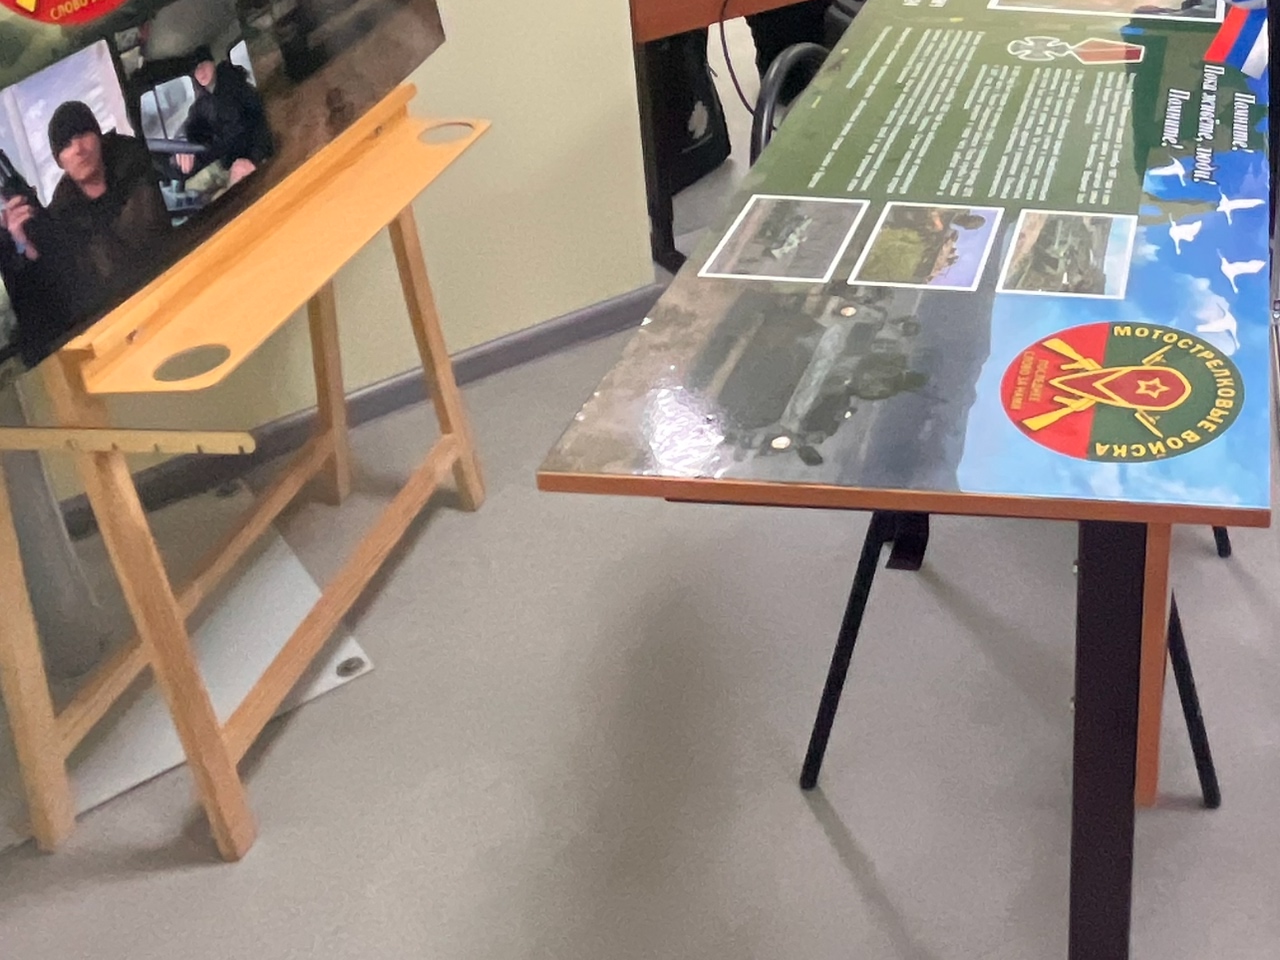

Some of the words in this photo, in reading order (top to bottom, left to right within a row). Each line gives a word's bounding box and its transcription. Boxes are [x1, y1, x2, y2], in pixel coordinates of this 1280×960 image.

[1202, 64, 1225, 91] Пока
[1161, 88, 1191, 150] Помните!
[1194, 92, 1221, 142] живёте,
[1231, 92, 1256, 153] Помните!
[1193, 144, 1217, 186] люди!
[1112, 325, 1236, 433] МОТОСТРЕЛКОВЫЕ
[1095, 429, 1201, 459] ВОЙСКА
